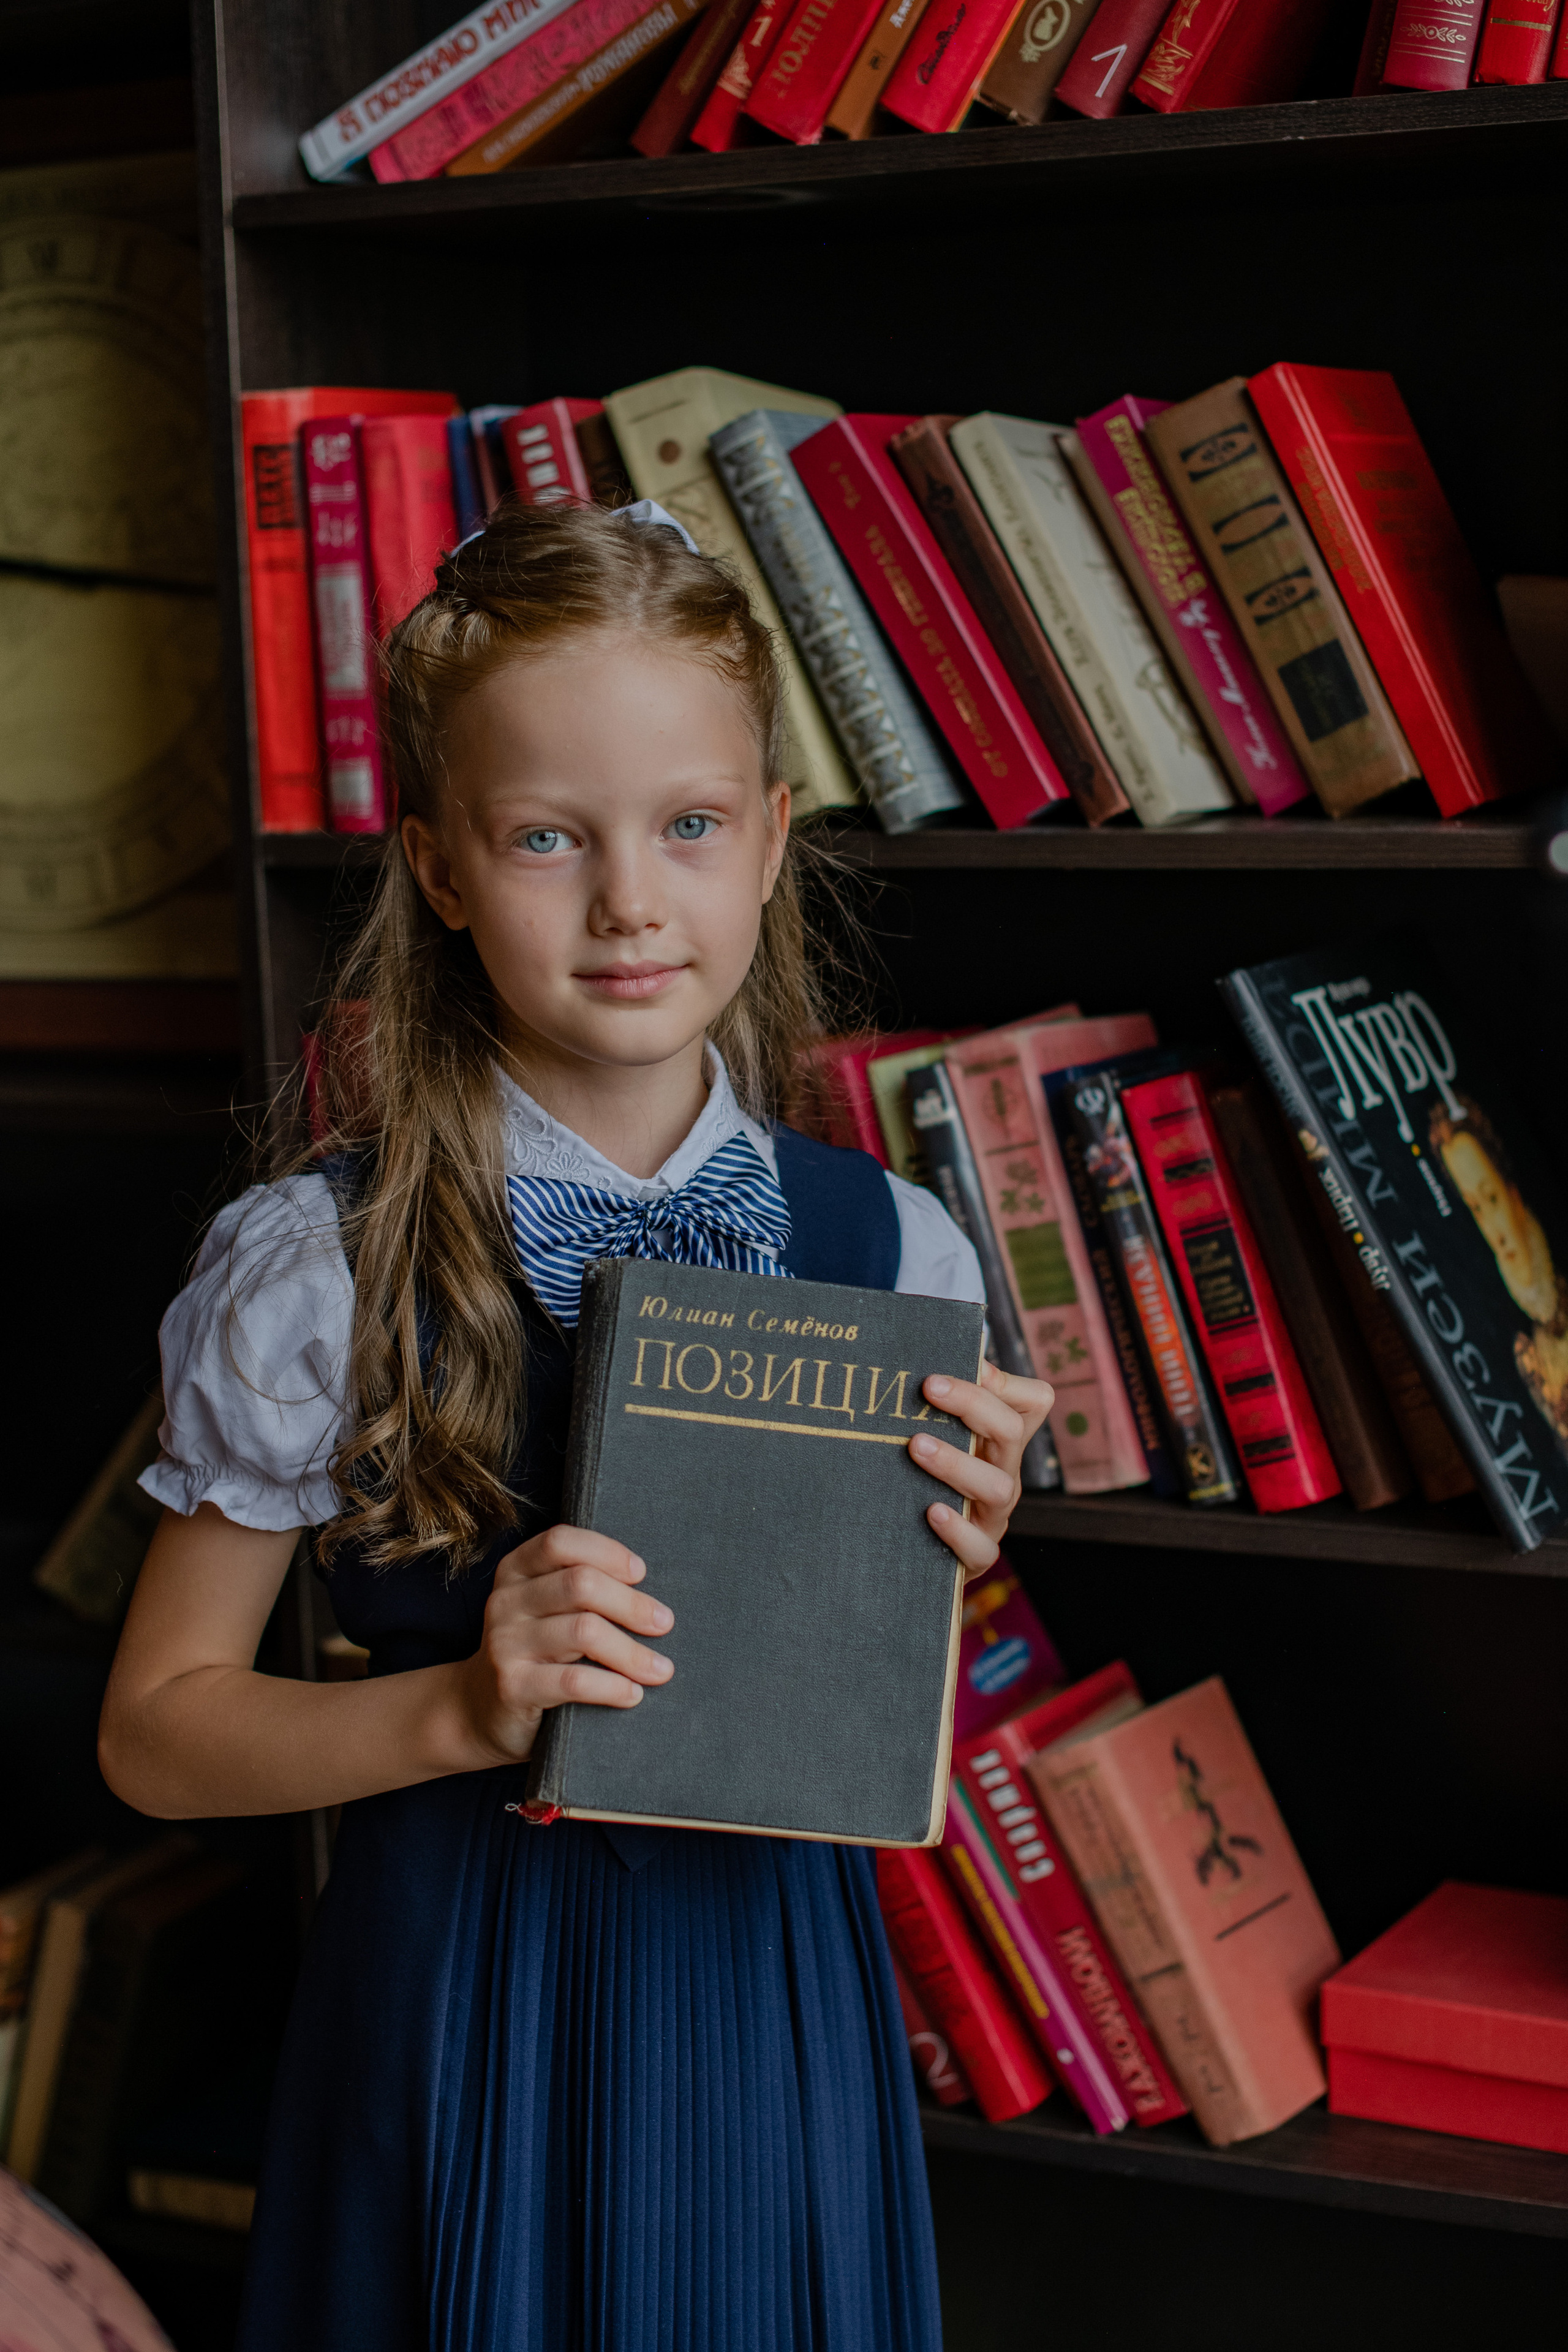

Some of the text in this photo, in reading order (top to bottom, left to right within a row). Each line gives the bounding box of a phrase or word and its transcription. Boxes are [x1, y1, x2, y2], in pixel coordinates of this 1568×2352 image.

[337, 0, 544, 143] Я ПОЗНАЮ МИ
[1091, 43, 1128, 98] 1
[1292, 985, 1468, 1143] Лувр
[1319, 1167, 1392, 1292] Лувр Париж
[630, 1338, 949, 1423] ПОЗИЦИ
[639, 1295, 859, 1341] Юлиан Семёнов
[1397, 1231, 1558, 1523] Музеи
[968, 1747, 1056, 1885] Спартак
[911, 2032, 959, 2089] 2
